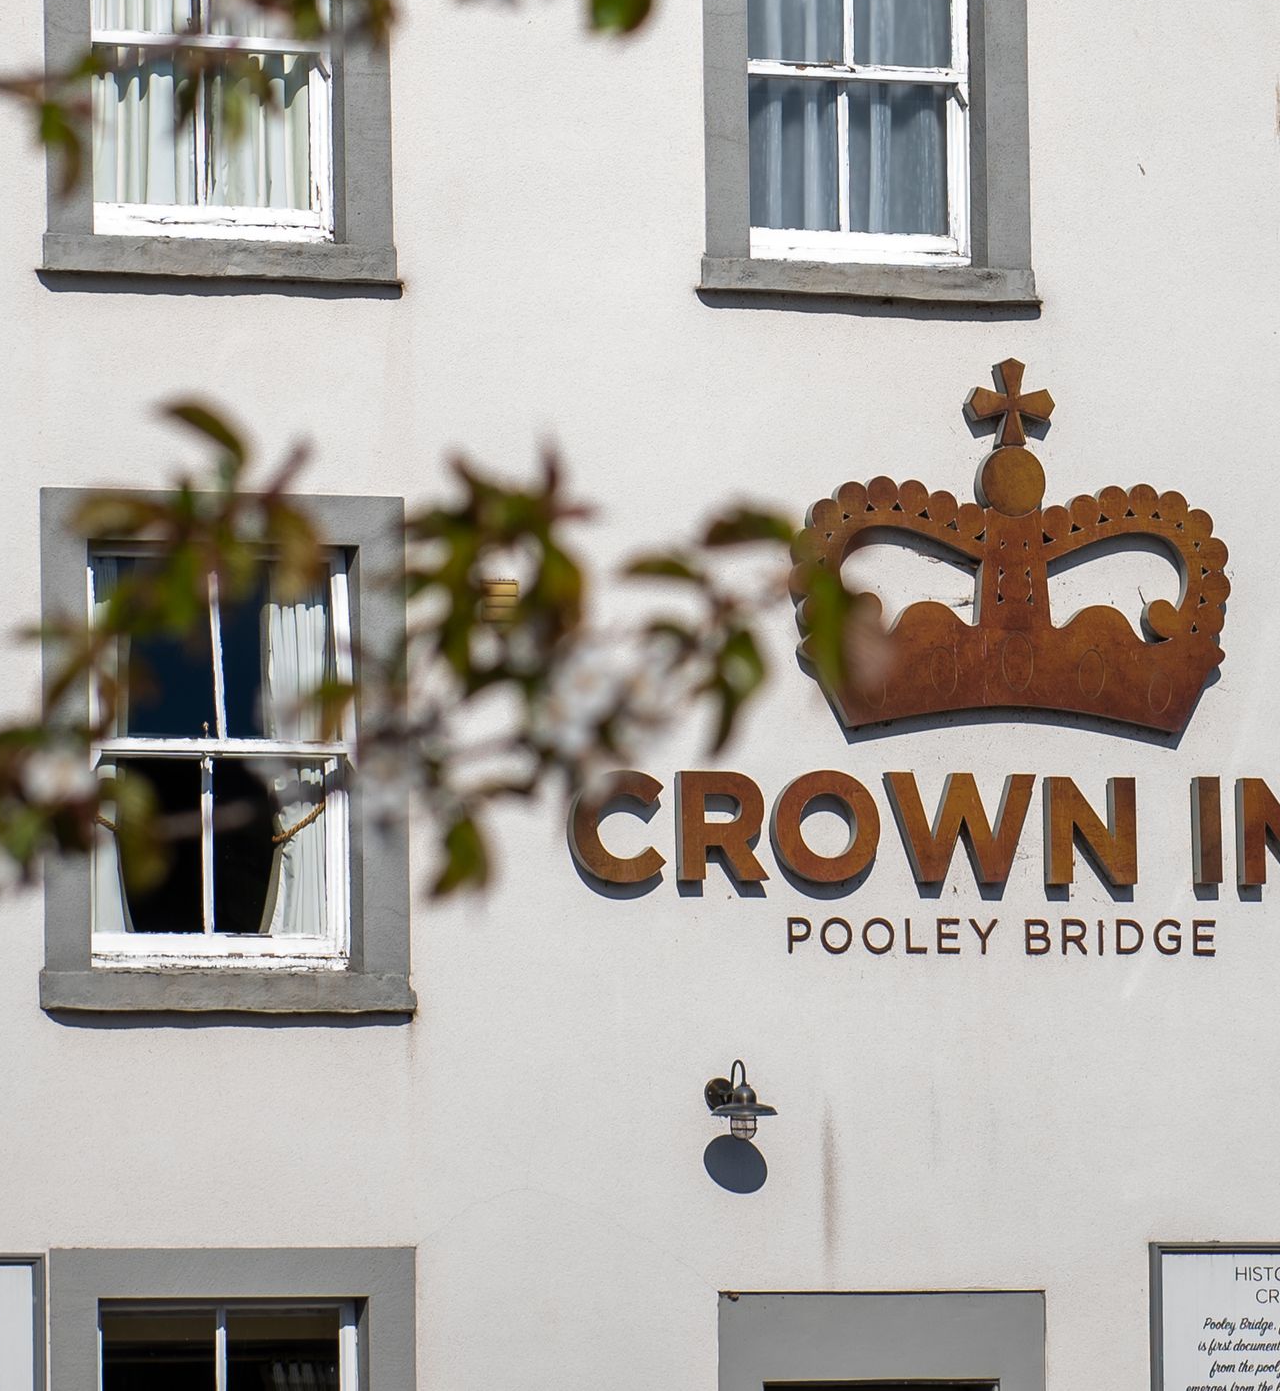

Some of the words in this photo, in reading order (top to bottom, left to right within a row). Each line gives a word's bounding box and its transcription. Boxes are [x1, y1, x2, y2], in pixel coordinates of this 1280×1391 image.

[567, 769, 1137, 887] CROWN
[786, 916, 999, 956] POOLEY
[1024, 918, 1217, 958] BRIDGE
[1202, 1317, 1237, 1337] Pooley
[1197, 1340, 1207, 1352] is
[1207, 1338, 1233, 1357] first
[1209, 1359, 1236, 1379] from
[1237, 1359, 1255, 1373] the
[1254, 1360, 1280, 1377] pool
